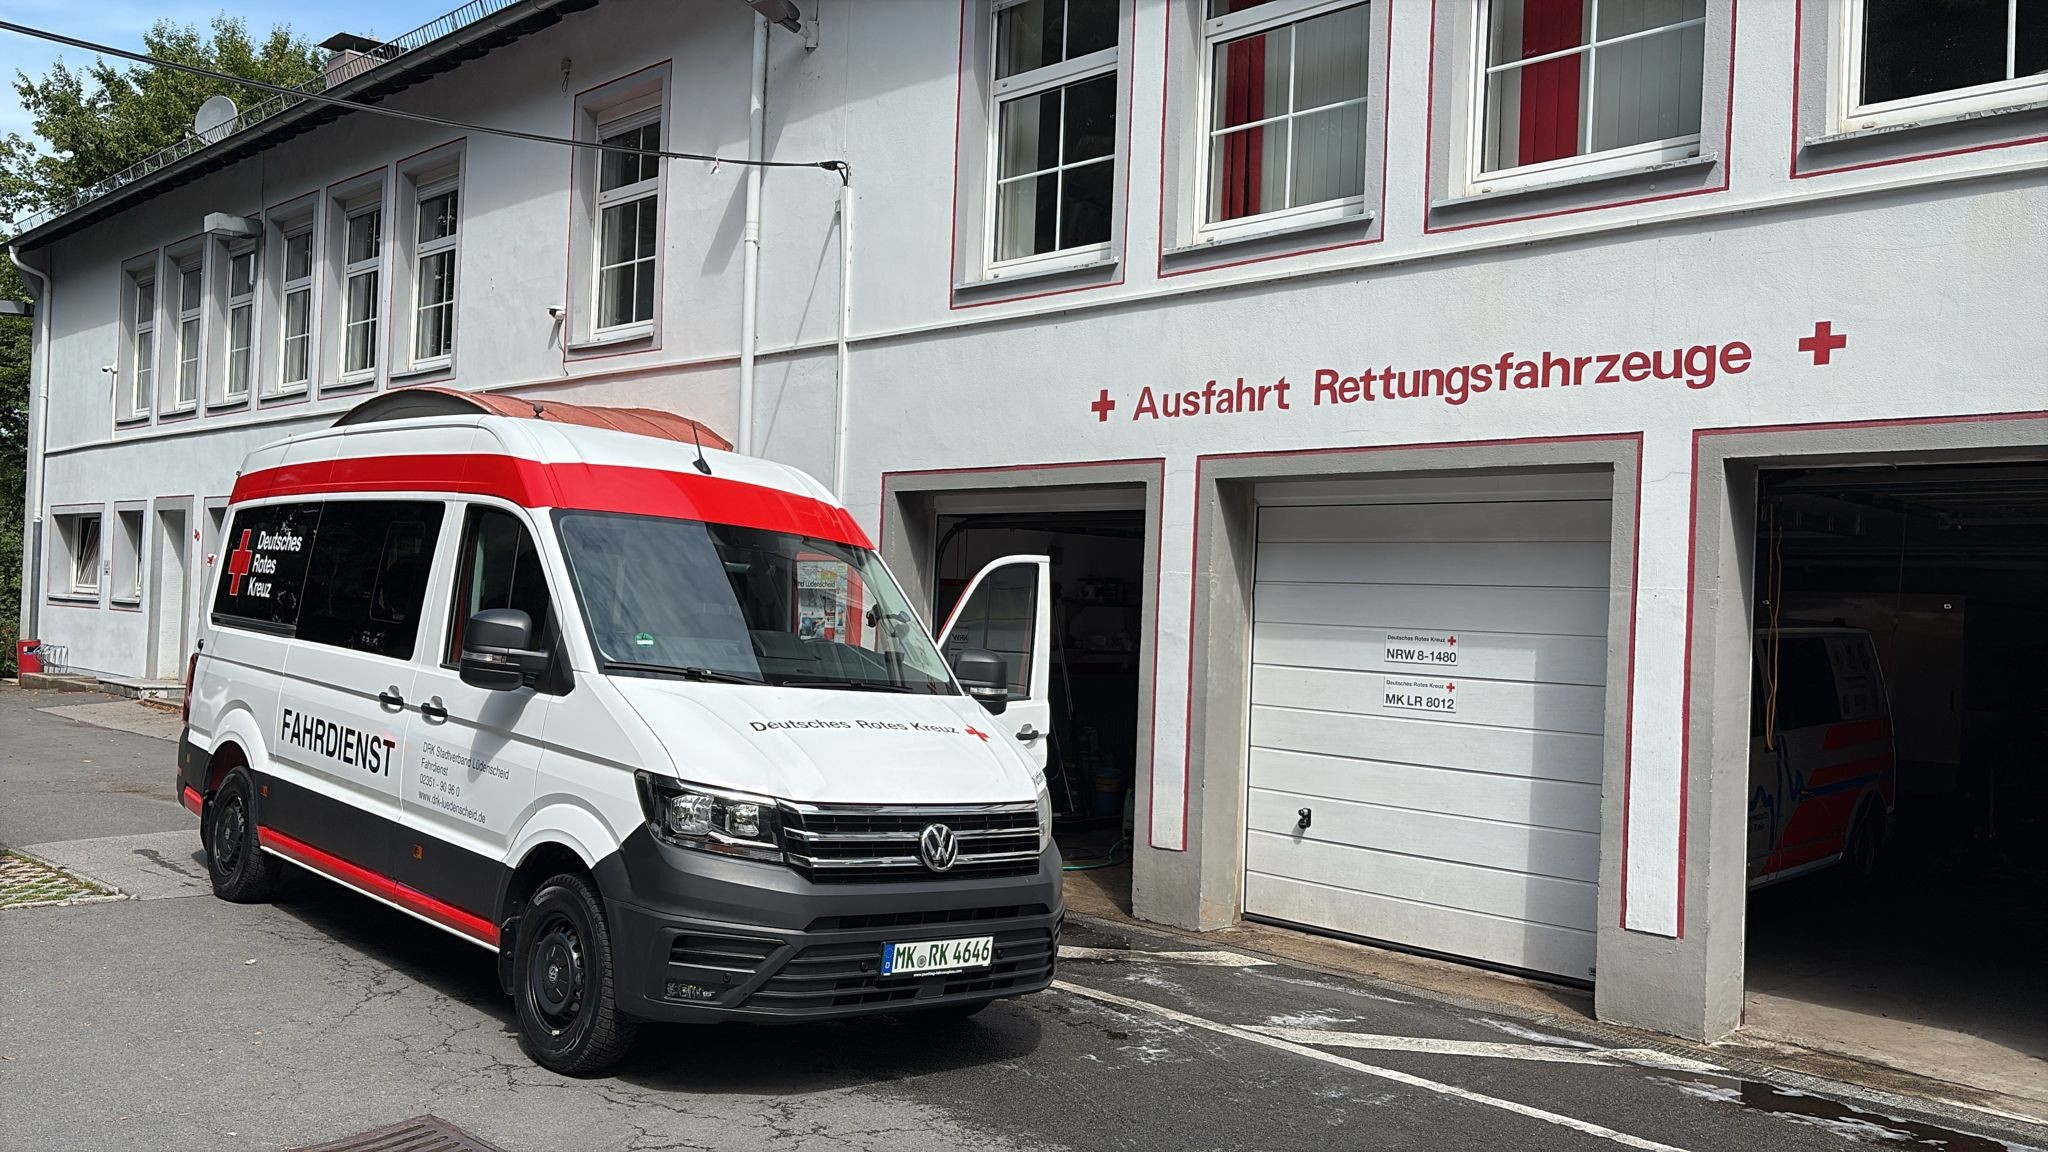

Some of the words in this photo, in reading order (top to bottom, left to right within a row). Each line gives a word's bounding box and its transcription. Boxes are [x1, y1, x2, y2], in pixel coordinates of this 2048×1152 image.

[1132, 376, 1290, 421] Ausfahrt
[1313, 341, 1752, 406] Rettungsfahrzeuge
[257, 530, 303, 552] Deutsches
[252, 553, 277, 574] Rotes
[247, 576, 272, 598] Kreuz
[1386, 648, 1415, 660] NRW
[1417, 650, 1457, 663] 8-1480
[1385, 694, 1405, 705] MK
[1406, 695, 1423, 707] LR
[1426, 697, 1455, 710] 8012
[749, 719, 851, 732] Deutsches
[855, 720, 908, 731] Rotes
[910, 721, 960, 735] Kreuz
[281, 708, 396, 777] FAHRDIENST
[420, 757, 449, 777] Fahrdienst
[422, 741, 437, 756] DRK
[436, 745, 473, 768] Stadtverband
[472, 758, 510, 780] Lüdenscheid
[419, 773, 436, 788] 02351
[439, 780, 448, 793] 90
[447, 783, 456, 796] 96
[455, 786, 461, 798] 0
[418, 791, 486, 824] www.drk-luedenscheid.de
[884, 961, 891, 969] D
[894, 945, 918, 970] MK
[928, 943, 950, 967] RK
[952, 939, 990, 964] 4646
